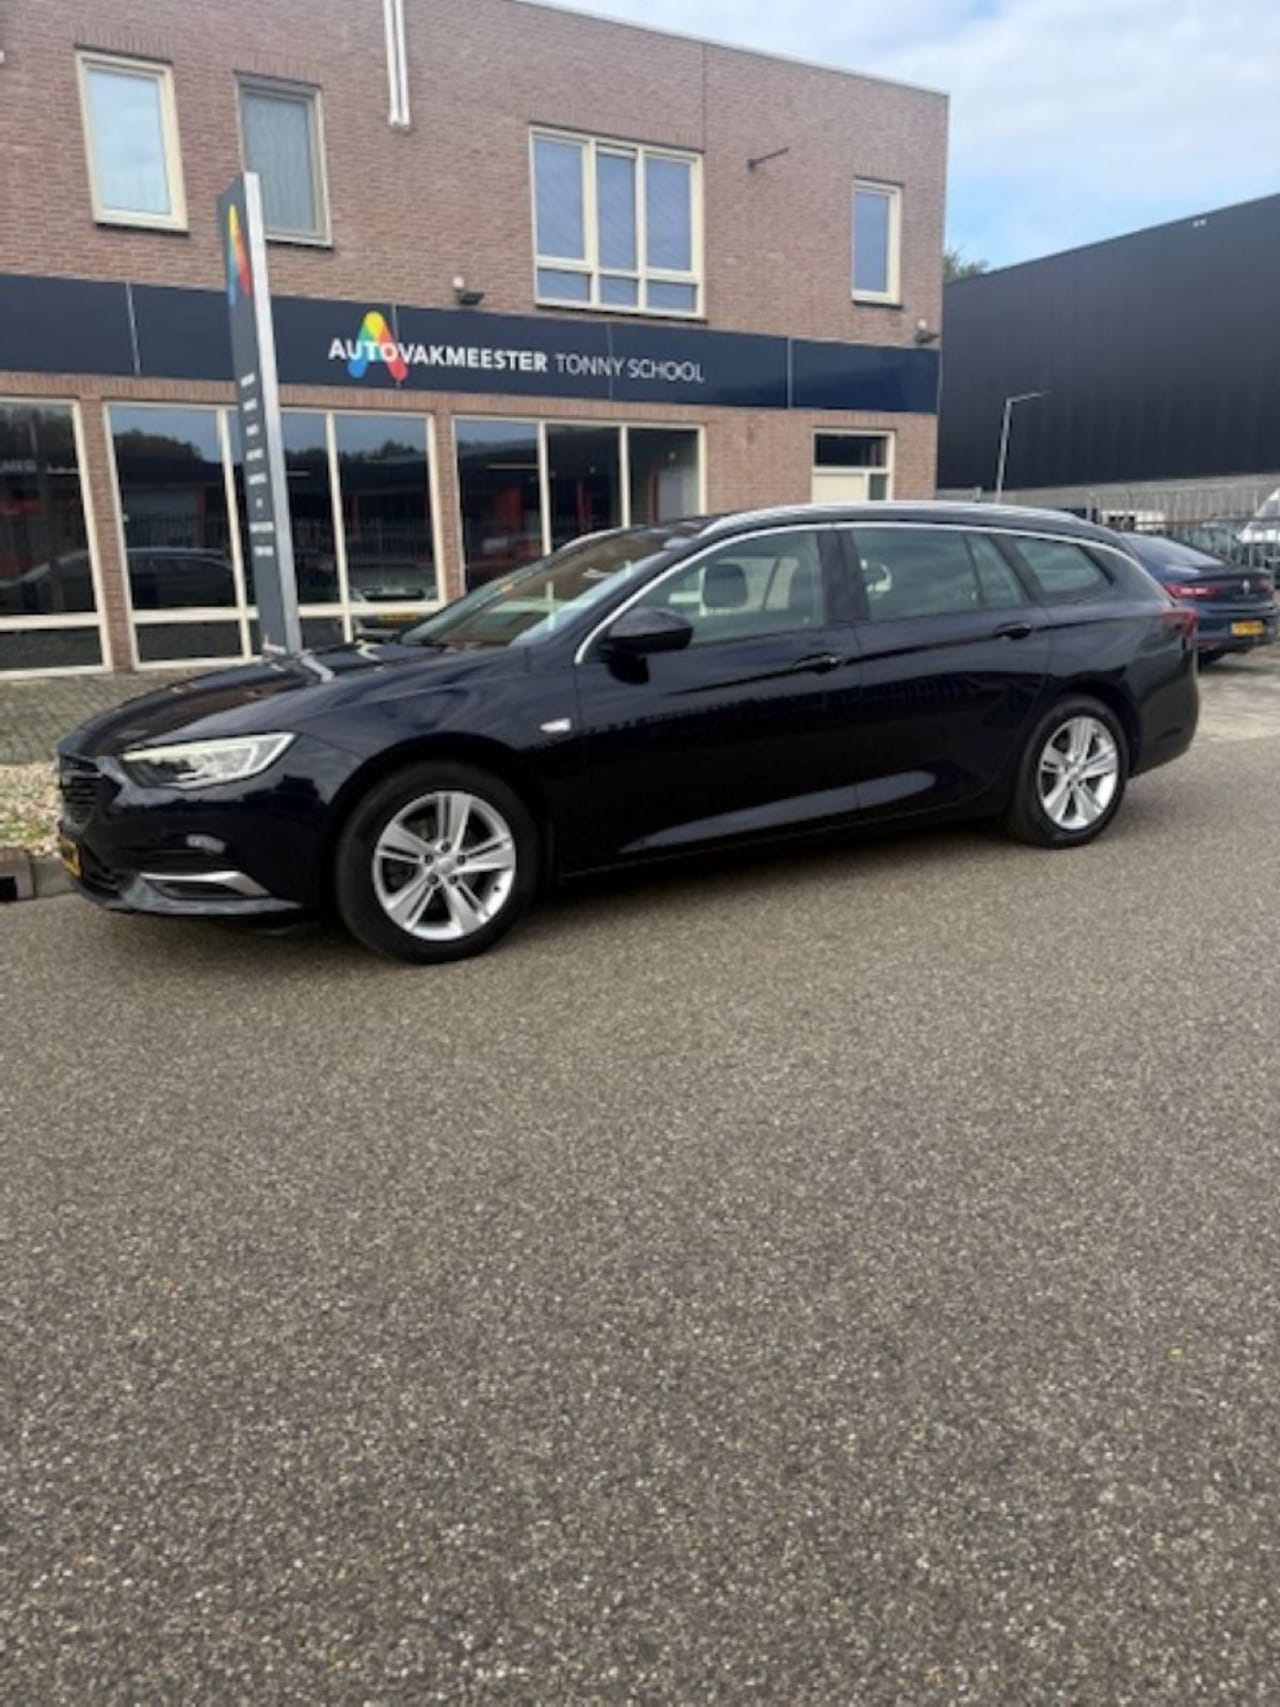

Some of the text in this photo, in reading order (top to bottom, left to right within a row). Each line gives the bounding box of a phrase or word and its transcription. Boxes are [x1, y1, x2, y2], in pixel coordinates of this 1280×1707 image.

[328, 337, 705, 384] AUTOVAKMEESTER TONNY SCHOOL
